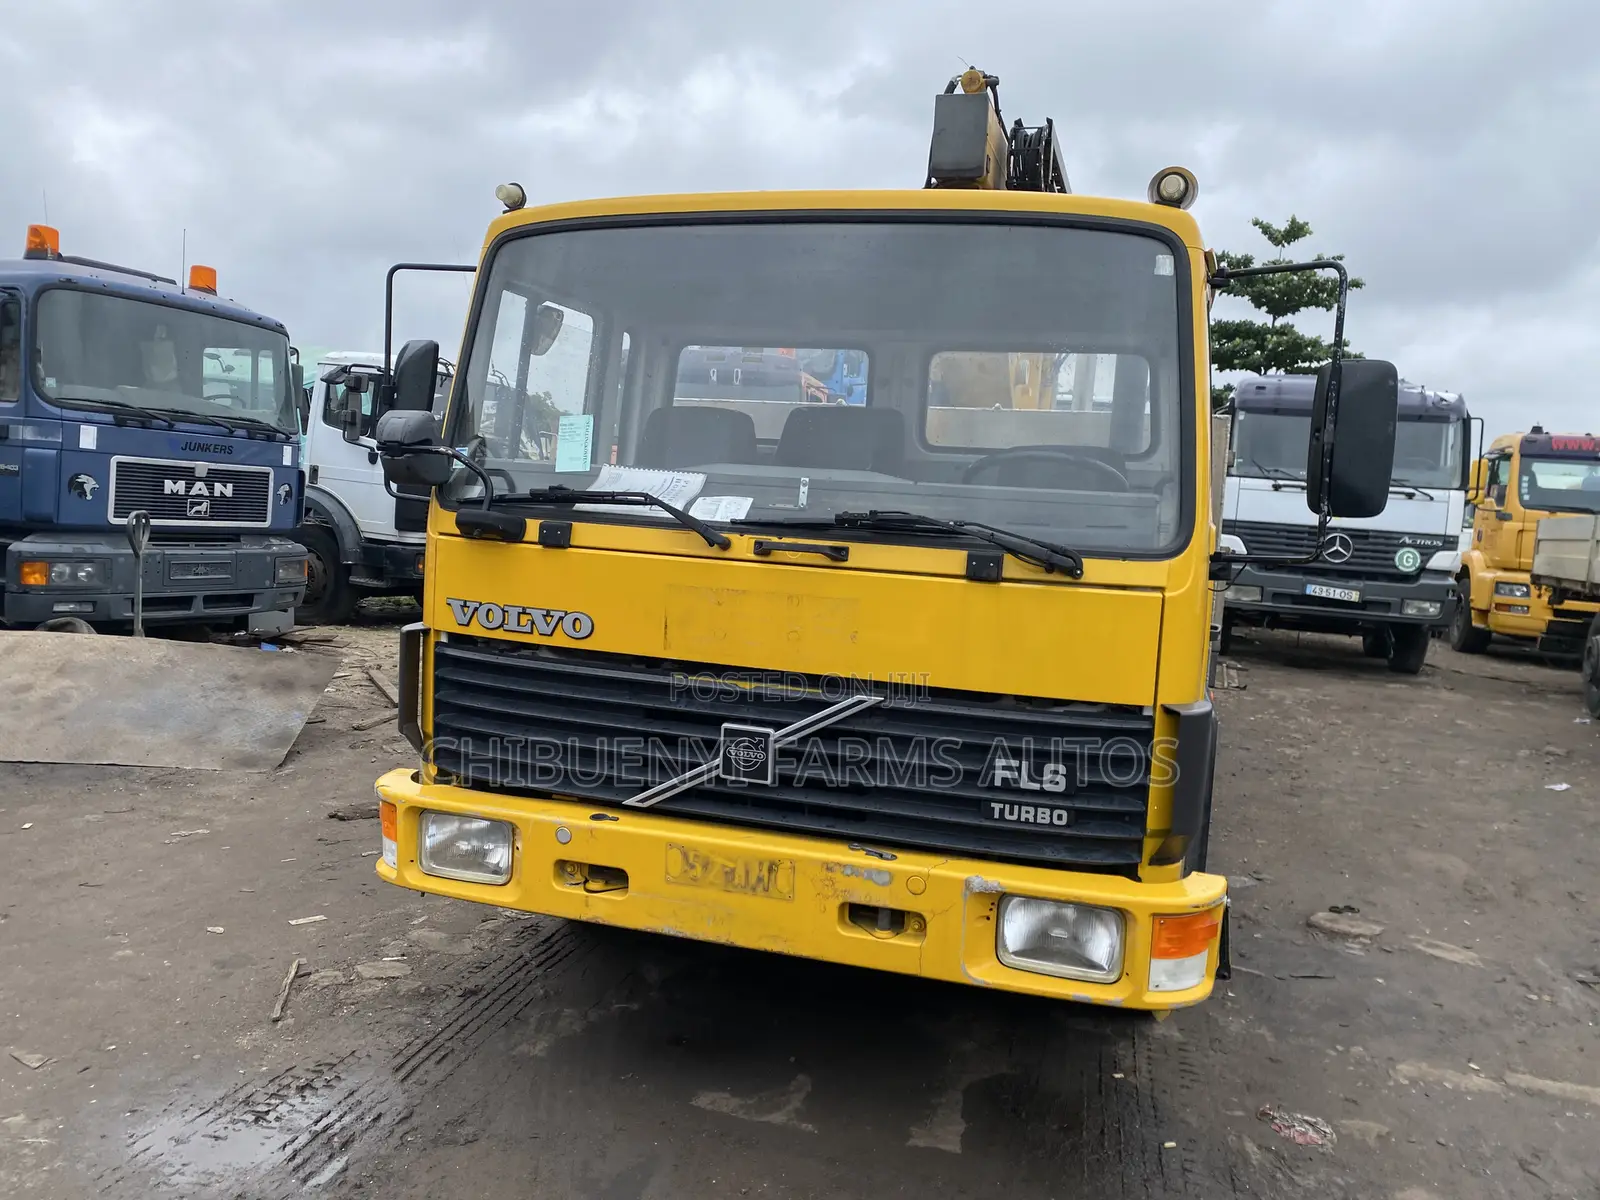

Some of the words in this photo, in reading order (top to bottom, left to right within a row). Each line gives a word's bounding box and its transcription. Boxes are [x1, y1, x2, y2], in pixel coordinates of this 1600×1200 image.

[180, 441, 234, 455] JUNKERS
[163, 479, 233, 498] MAN
[1403, 552, 1414, 567] G
[446, 597, 594, 640] VOLVO
[729, 749, 764, 759] VOLVO
[994, 758, 1067, 793] FL6
[990, 802, 1068, 826] TURBO
